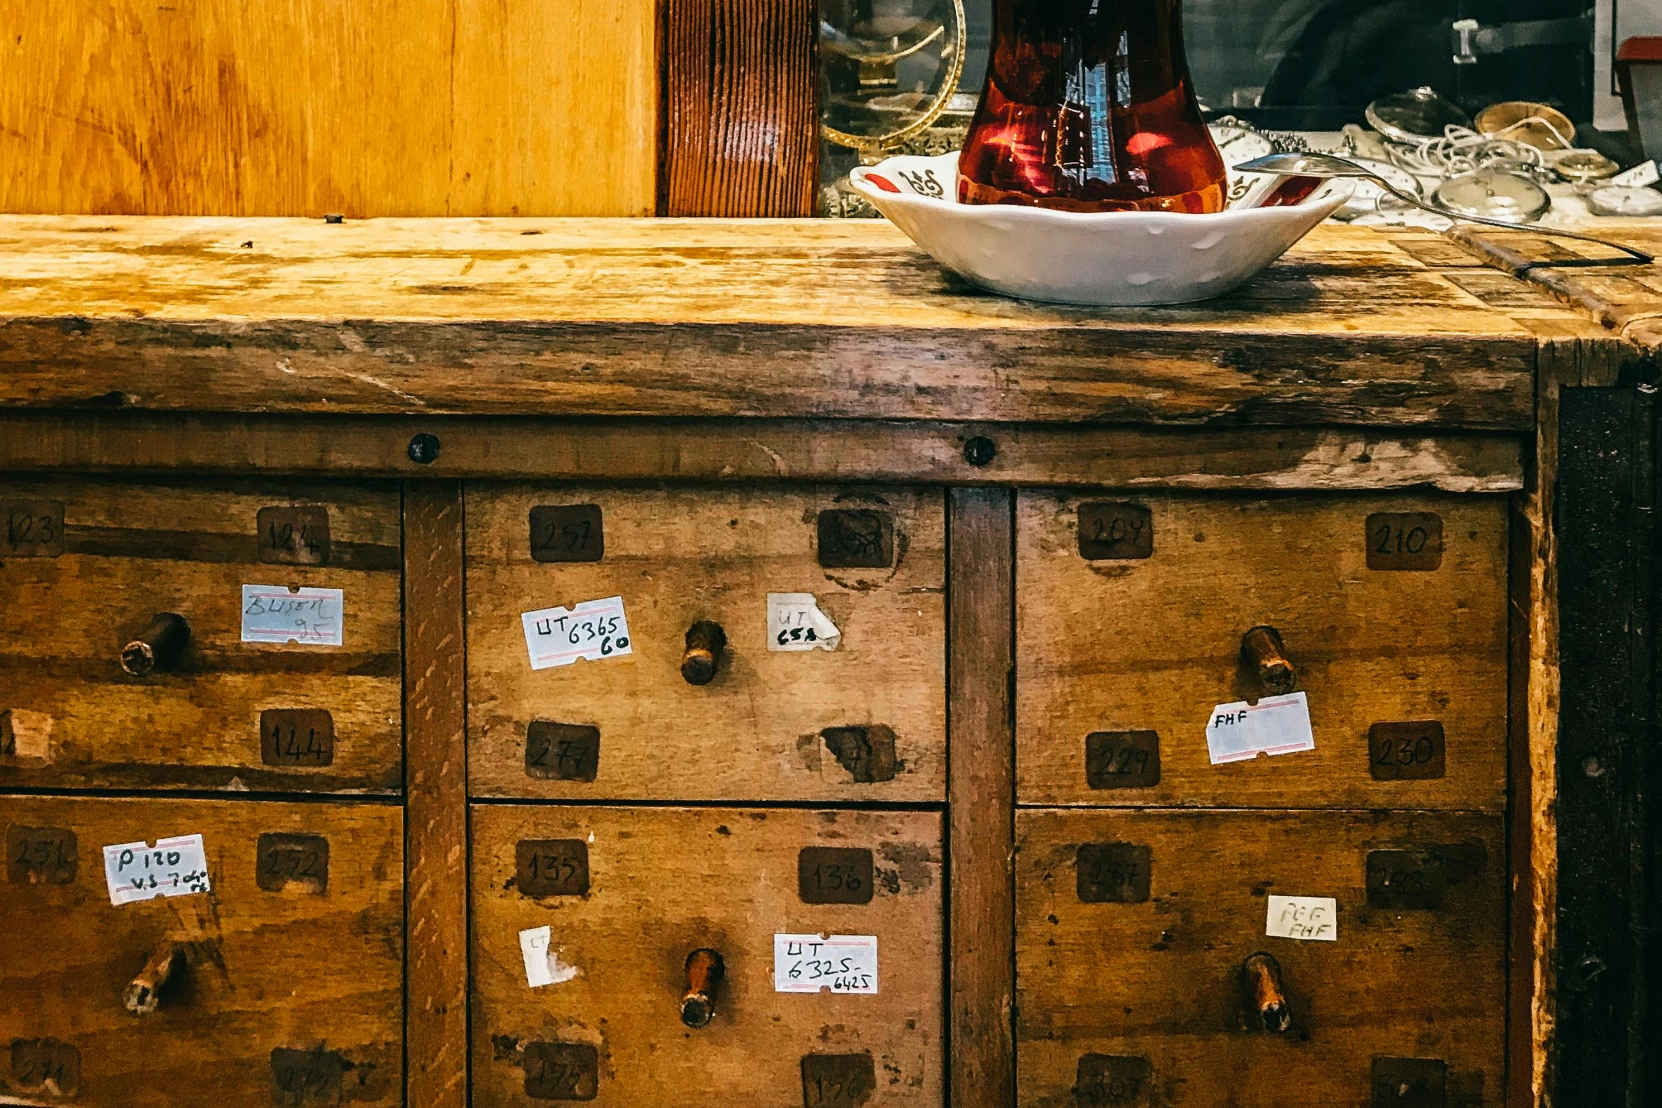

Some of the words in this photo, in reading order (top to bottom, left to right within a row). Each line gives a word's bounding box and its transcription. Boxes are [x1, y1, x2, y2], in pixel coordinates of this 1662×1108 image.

[537, 520, 591, 551] 257
[1375, 524, 1428, 554] 210
[568, 616, 621, 644] 6365
[1214, 709, 1248, 728] FHF
[271, 724, 329, 760] 144
[1375, 735, 1434, 765] 230
[144, 851, 181, 869] 120
[528, 852, 579, 883] 135
[787, 941, 824, 956] UT
[833, 975, 873, 991] 6425
